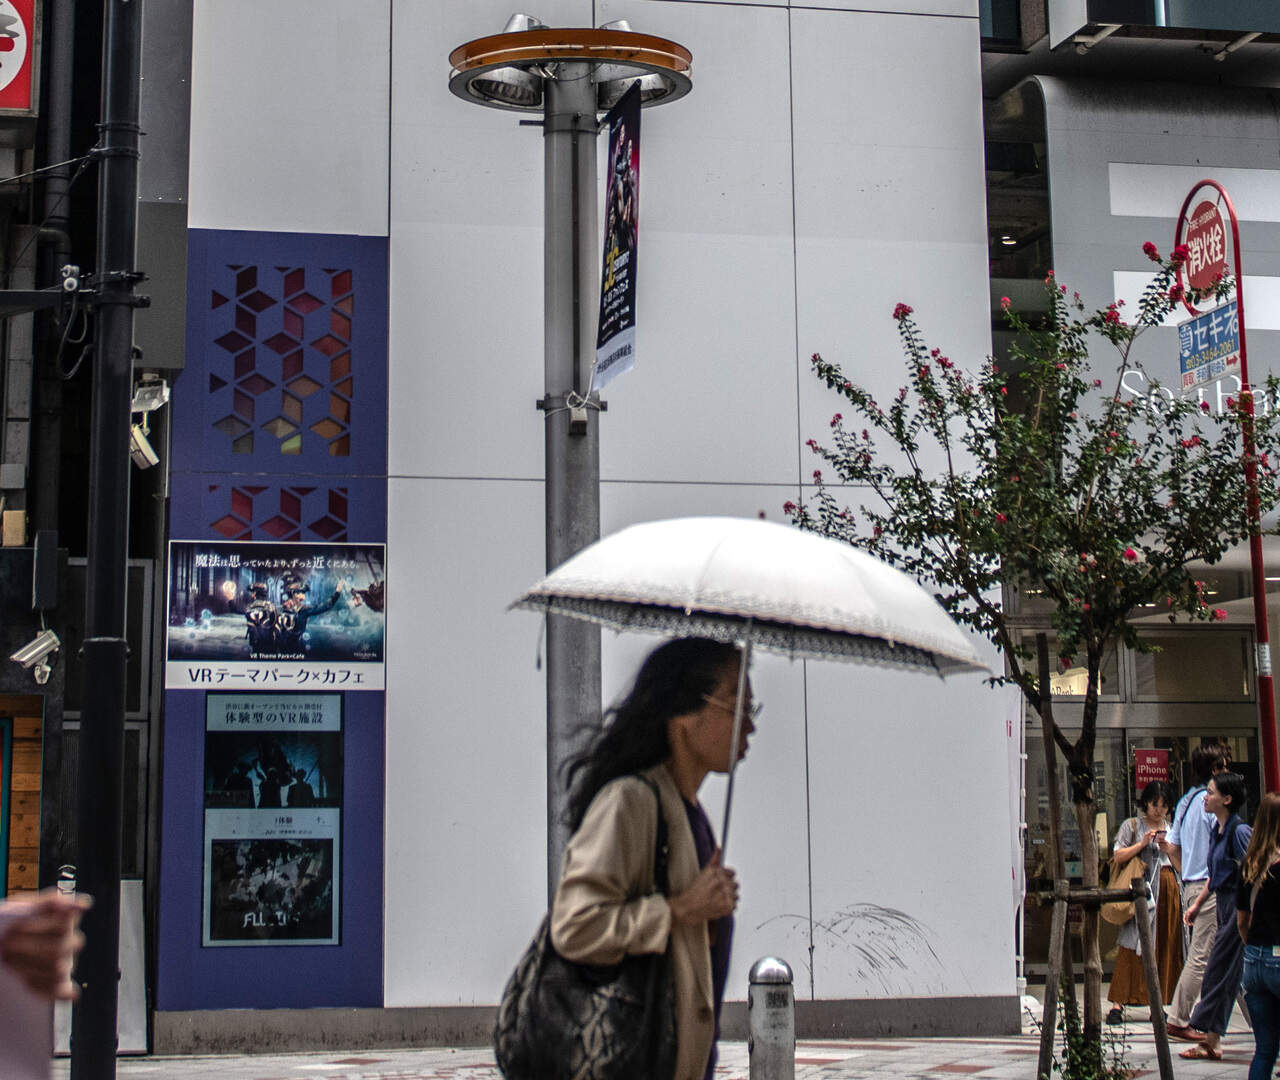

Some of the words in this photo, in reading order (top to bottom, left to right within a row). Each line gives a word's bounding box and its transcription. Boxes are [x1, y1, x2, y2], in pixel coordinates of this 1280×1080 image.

[1187, 222, 1224, 278] 消火栓
[1194, 304, 1239, 351] セキネ
[195, 554, 361, 569] 魔法は思っていたより、ずっと近くにある。
[224, 711, 323, 725] 体験型のVR施設
[1137, 764, 1167, 775] iPhone
